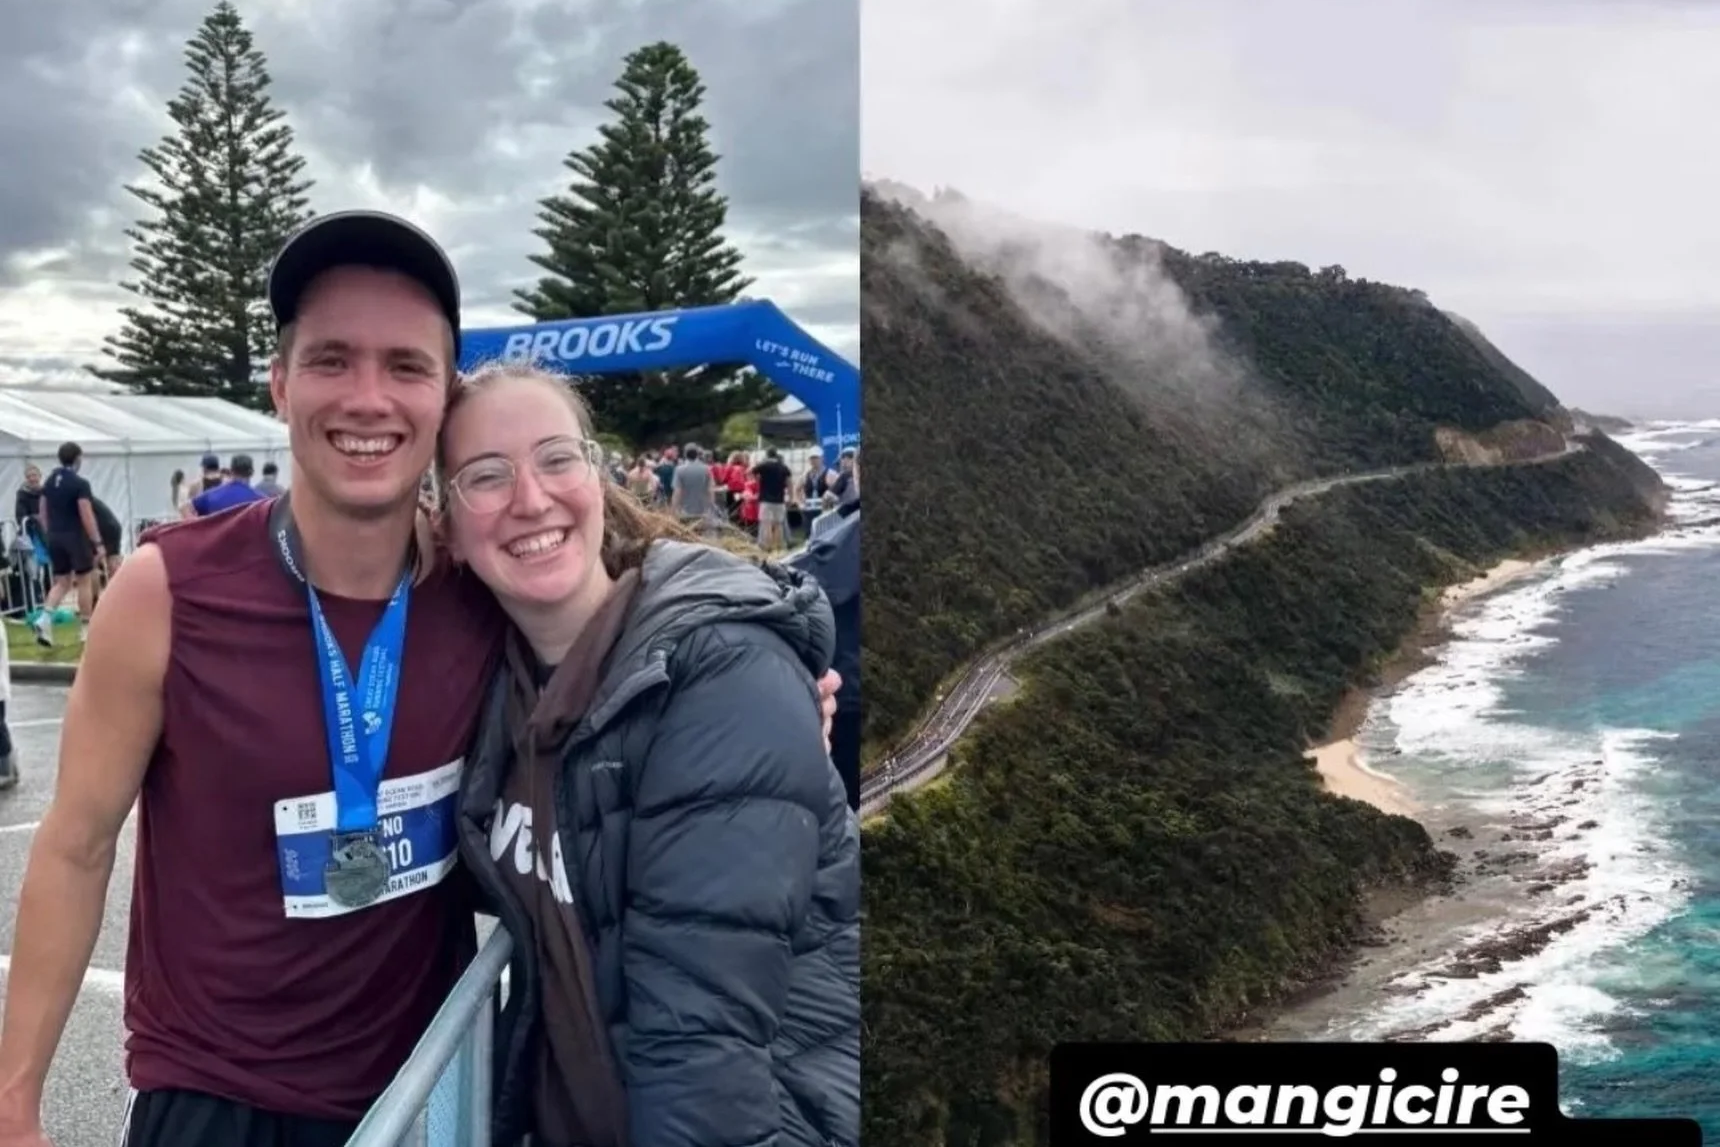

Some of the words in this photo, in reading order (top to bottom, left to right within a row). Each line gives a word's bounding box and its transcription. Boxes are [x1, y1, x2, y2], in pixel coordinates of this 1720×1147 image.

[504, 317, 679, 360] BROOKS
[755, 339, 789, 357] LET'S
[790, 349, 819, 366] RUN
[792, 361, 835, 383] THERE
[330, 659, 343, 686] HALF
[336, 690, 357, 754] MARATHON
[378, 815, 403, 838] NO
[383, 838, 413, 870] 10
